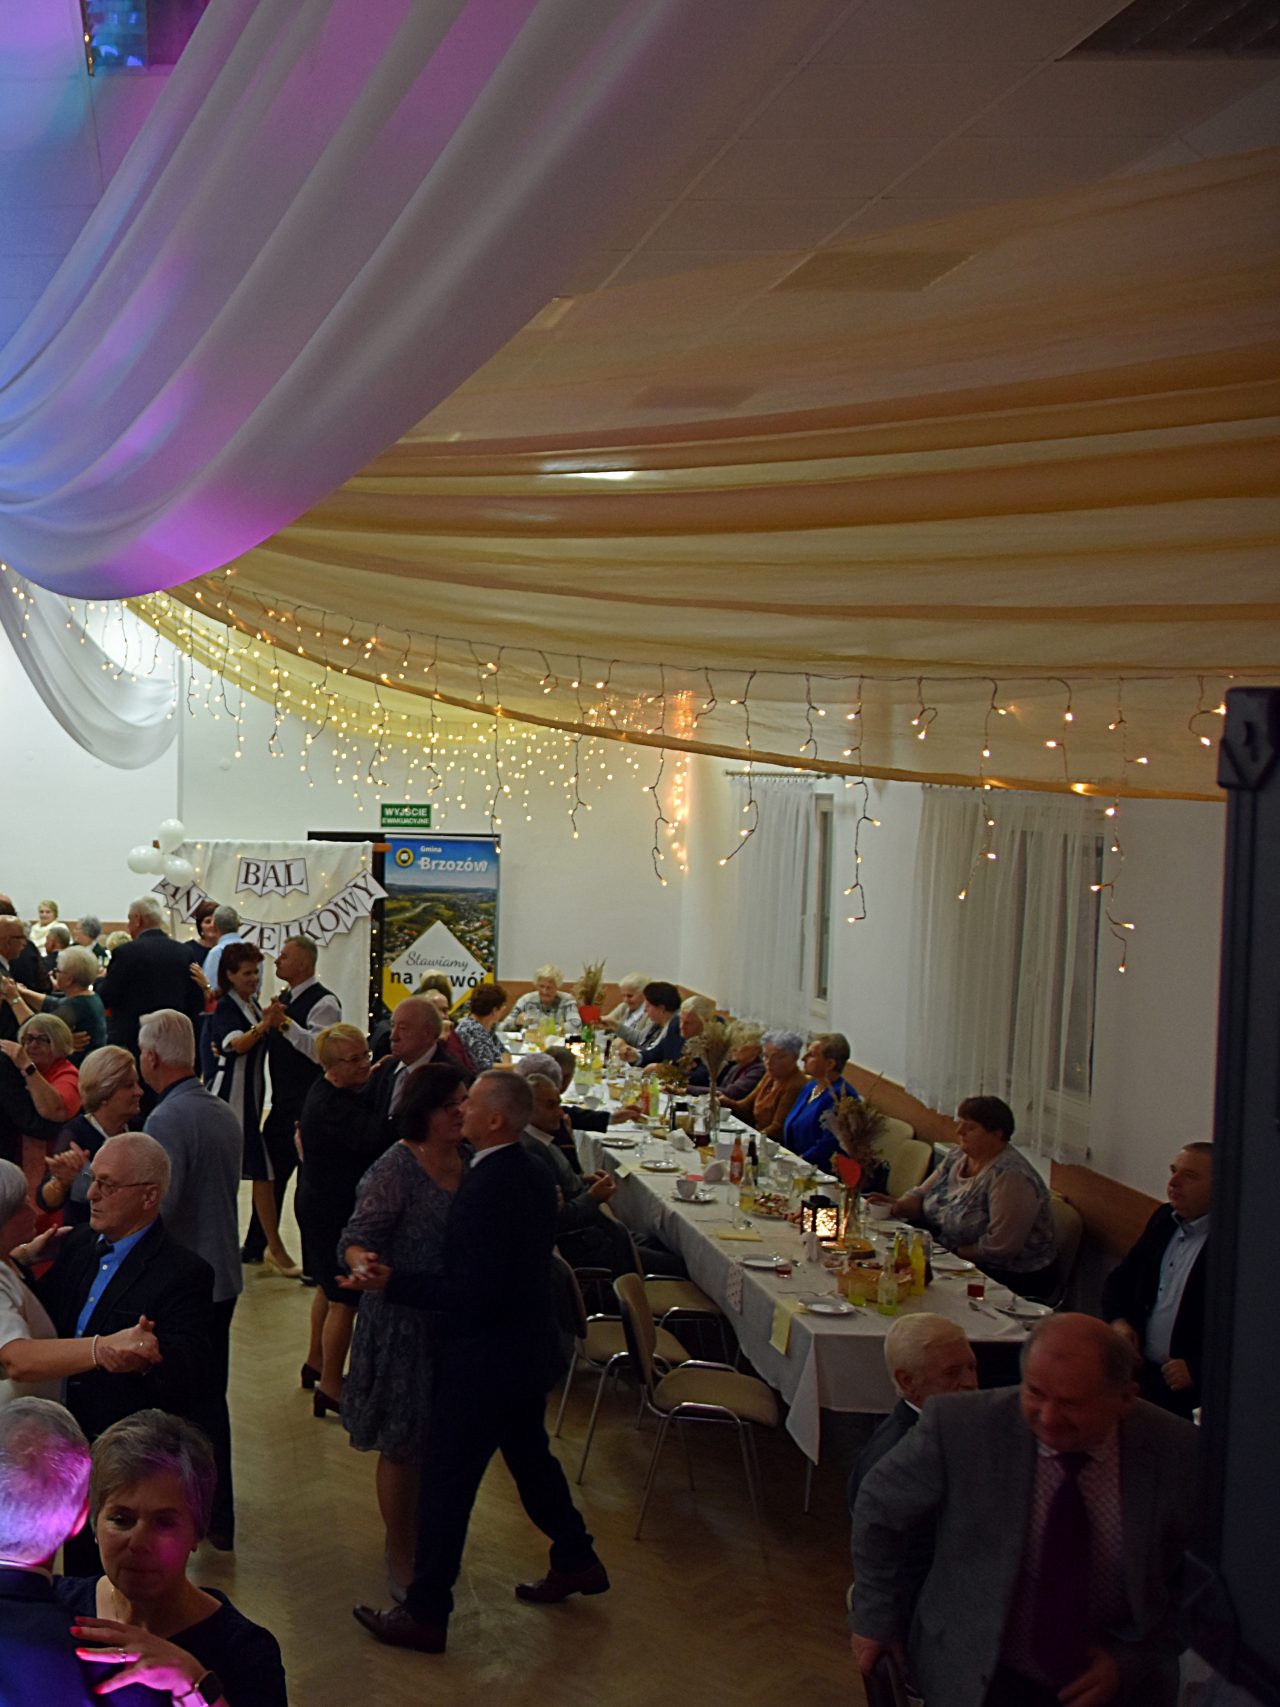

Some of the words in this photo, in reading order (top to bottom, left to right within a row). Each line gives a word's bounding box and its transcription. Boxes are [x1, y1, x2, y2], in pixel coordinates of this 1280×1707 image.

[420, 845, 442, 853] Gmina
[420, 857, 488, 872] Brzozów
[242, 861, 305, 888] BAL
[390, 971, 413, 985] na
